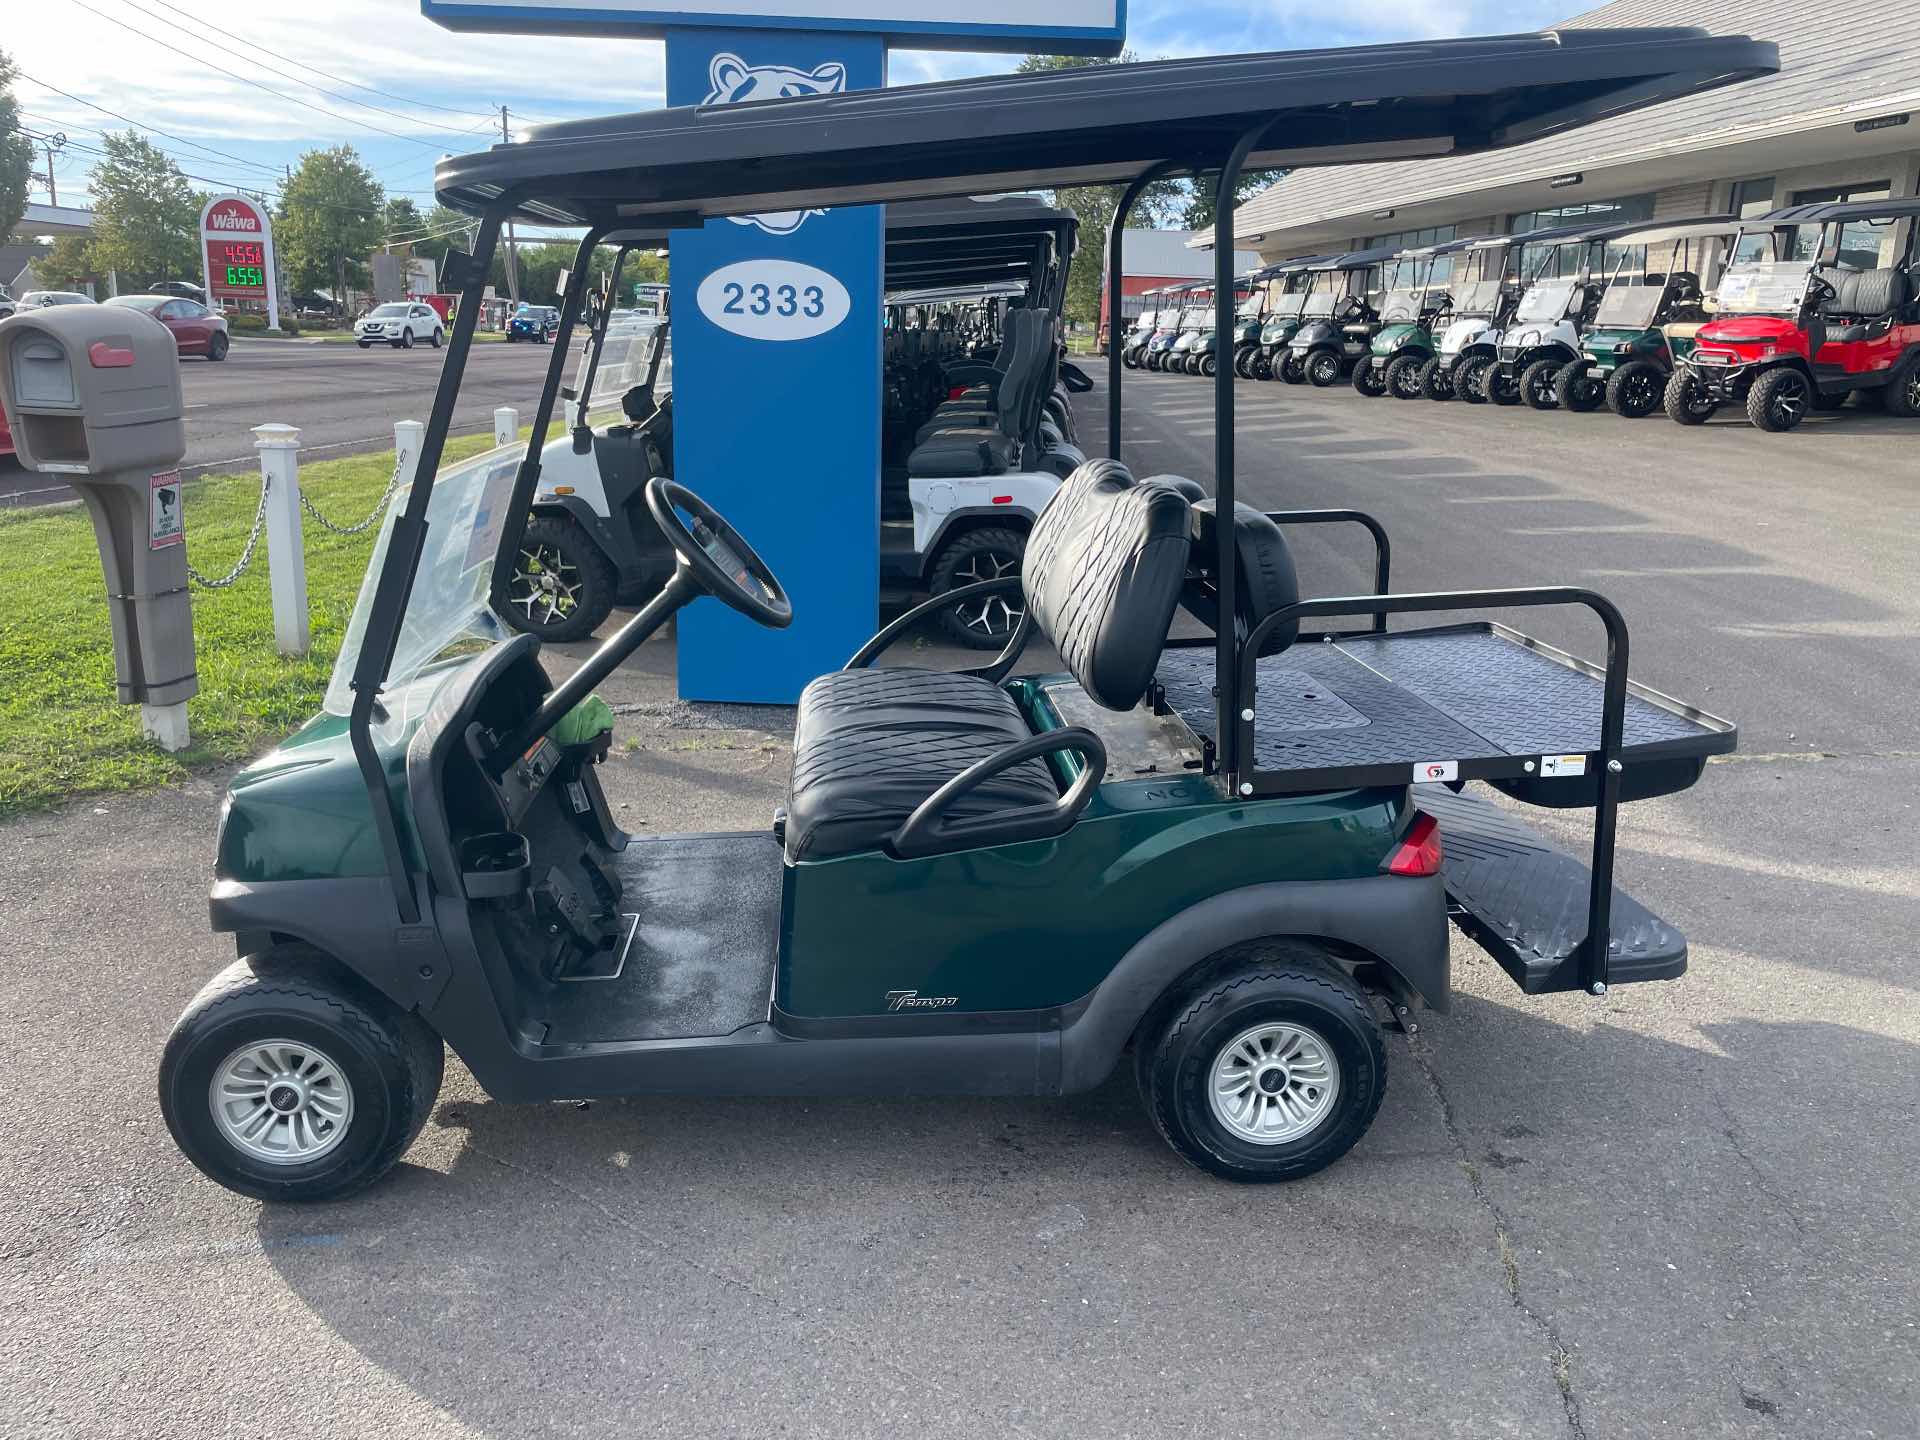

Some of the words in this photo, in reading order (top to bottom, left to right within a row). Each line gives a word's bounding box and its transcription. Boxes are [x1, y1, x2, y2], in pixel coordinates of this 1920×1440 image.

[212, 214, 256, 230] Wawa
[723, 282, 825, 318] 2333
[884, 990, 958, 1011] Tempo
